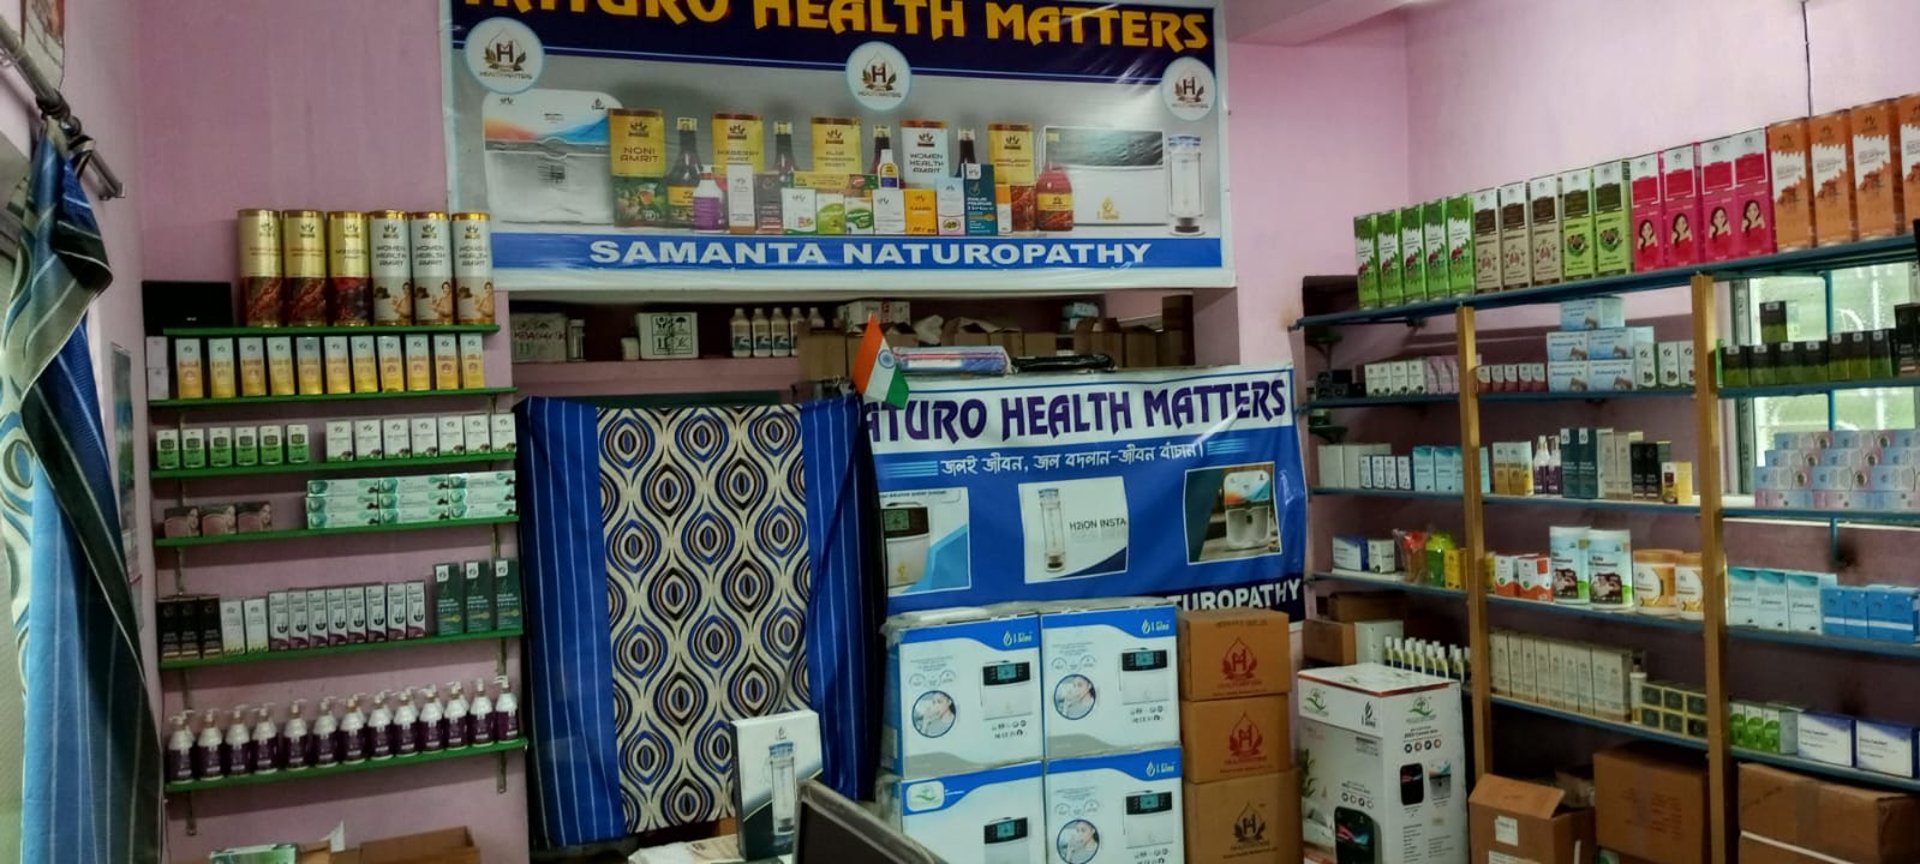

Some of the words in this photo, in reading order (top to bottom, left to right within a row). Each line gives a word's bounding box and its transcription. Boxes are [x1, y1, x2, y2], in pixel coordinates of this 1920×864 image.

[753, 0, 965, 41] HEALTH
[987, 2, 1210, 53] MATTERS
[623, 146, 656, 155] NONI
[590, 239, 828, 265] SAMANTA
[842, 241, 1153, 266] NATUROPATHY
[865, 397, 988, 444] ATURO
[1002, 390, 1133, 443] HEALTH
[1143, 379, 1287, 430] MATTERS
[940, 456, 978, 476] জলই
[982, 451, 1028, 474] জীবন,
[1034, 454, 1059, 471] জল
[1166, 578, 1301, 612] TUROPATHY
